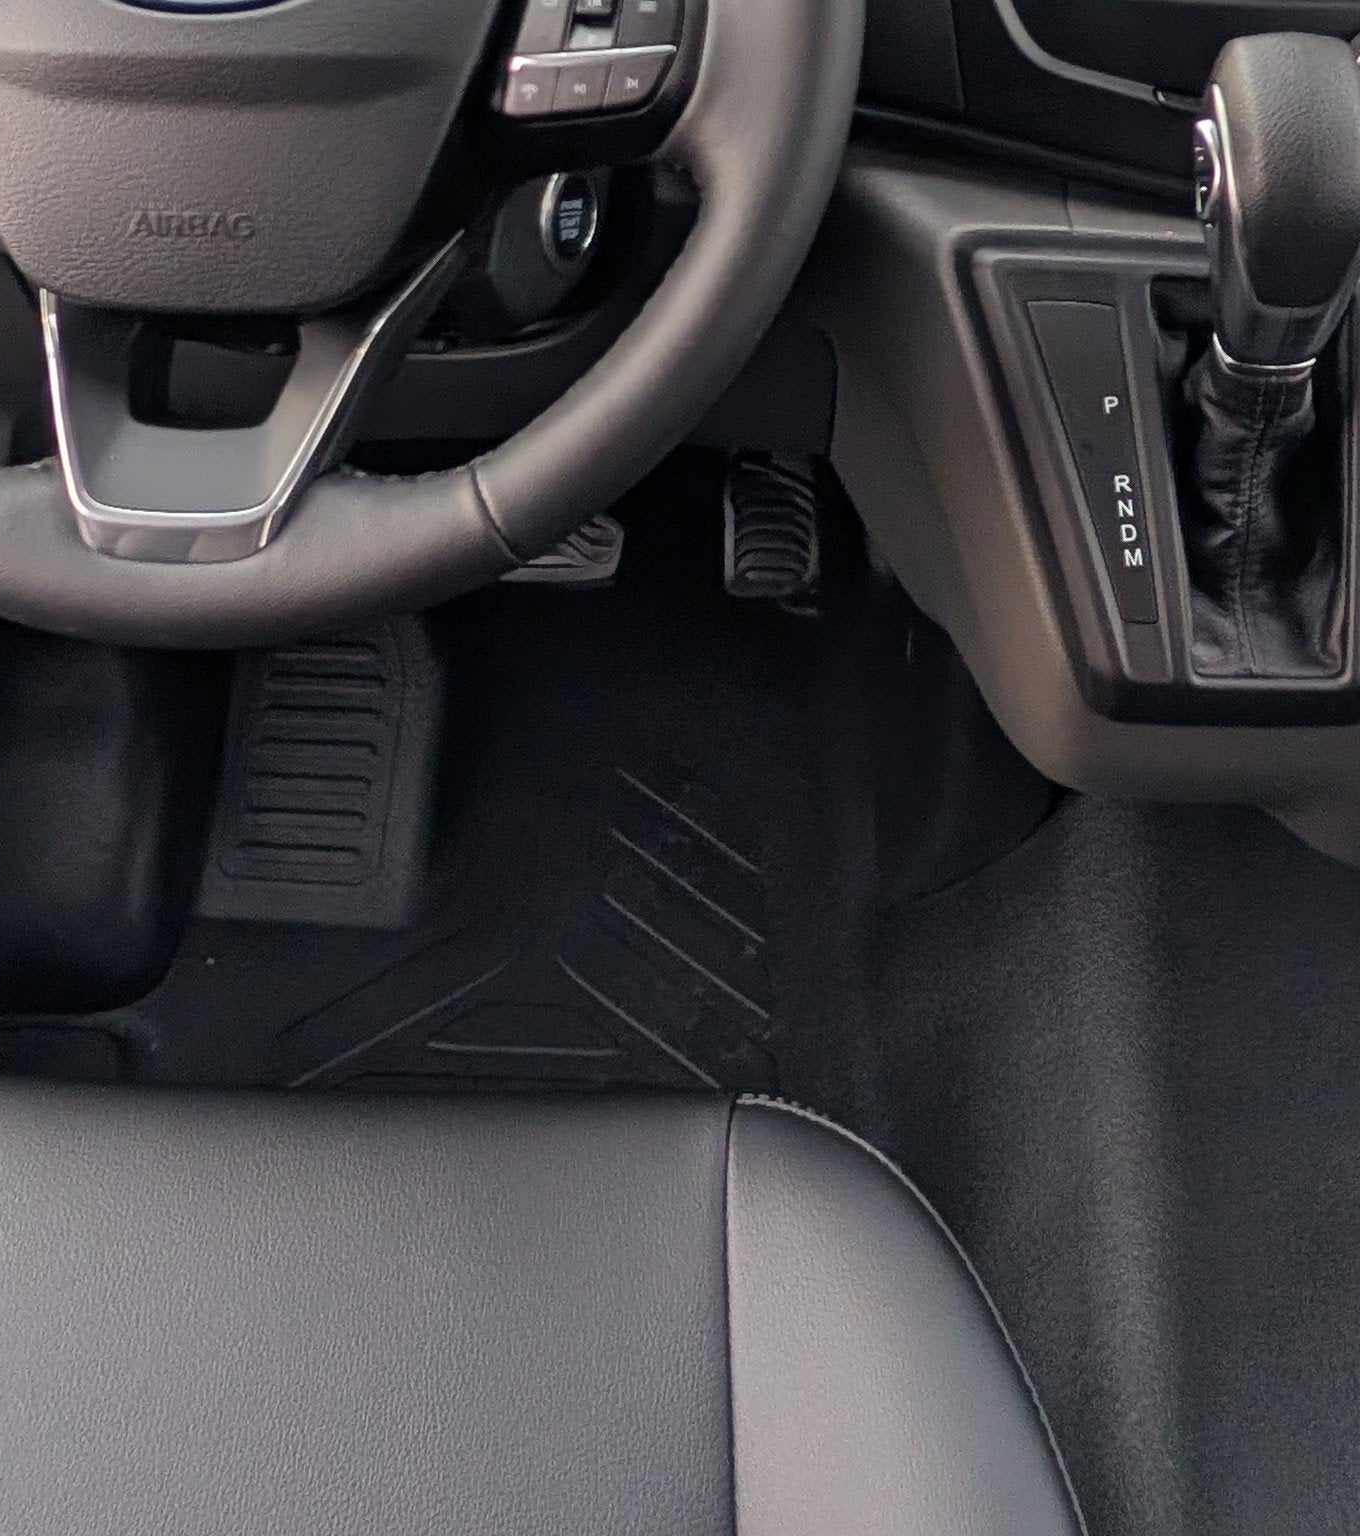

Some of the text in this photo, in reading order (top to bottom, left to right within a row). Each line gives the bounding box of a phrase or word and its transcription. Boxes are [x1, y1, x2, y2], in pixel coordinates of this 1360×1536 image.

[130, 209, 257, 243] AIRBAG
[1103, 395, 1119, 414] P
[1113, 474, 1133, 493] R
[1117, 498, 1135, 518] N
[1120, 523, 1138, 542] D
[1123, 548, 1144, 567] M
